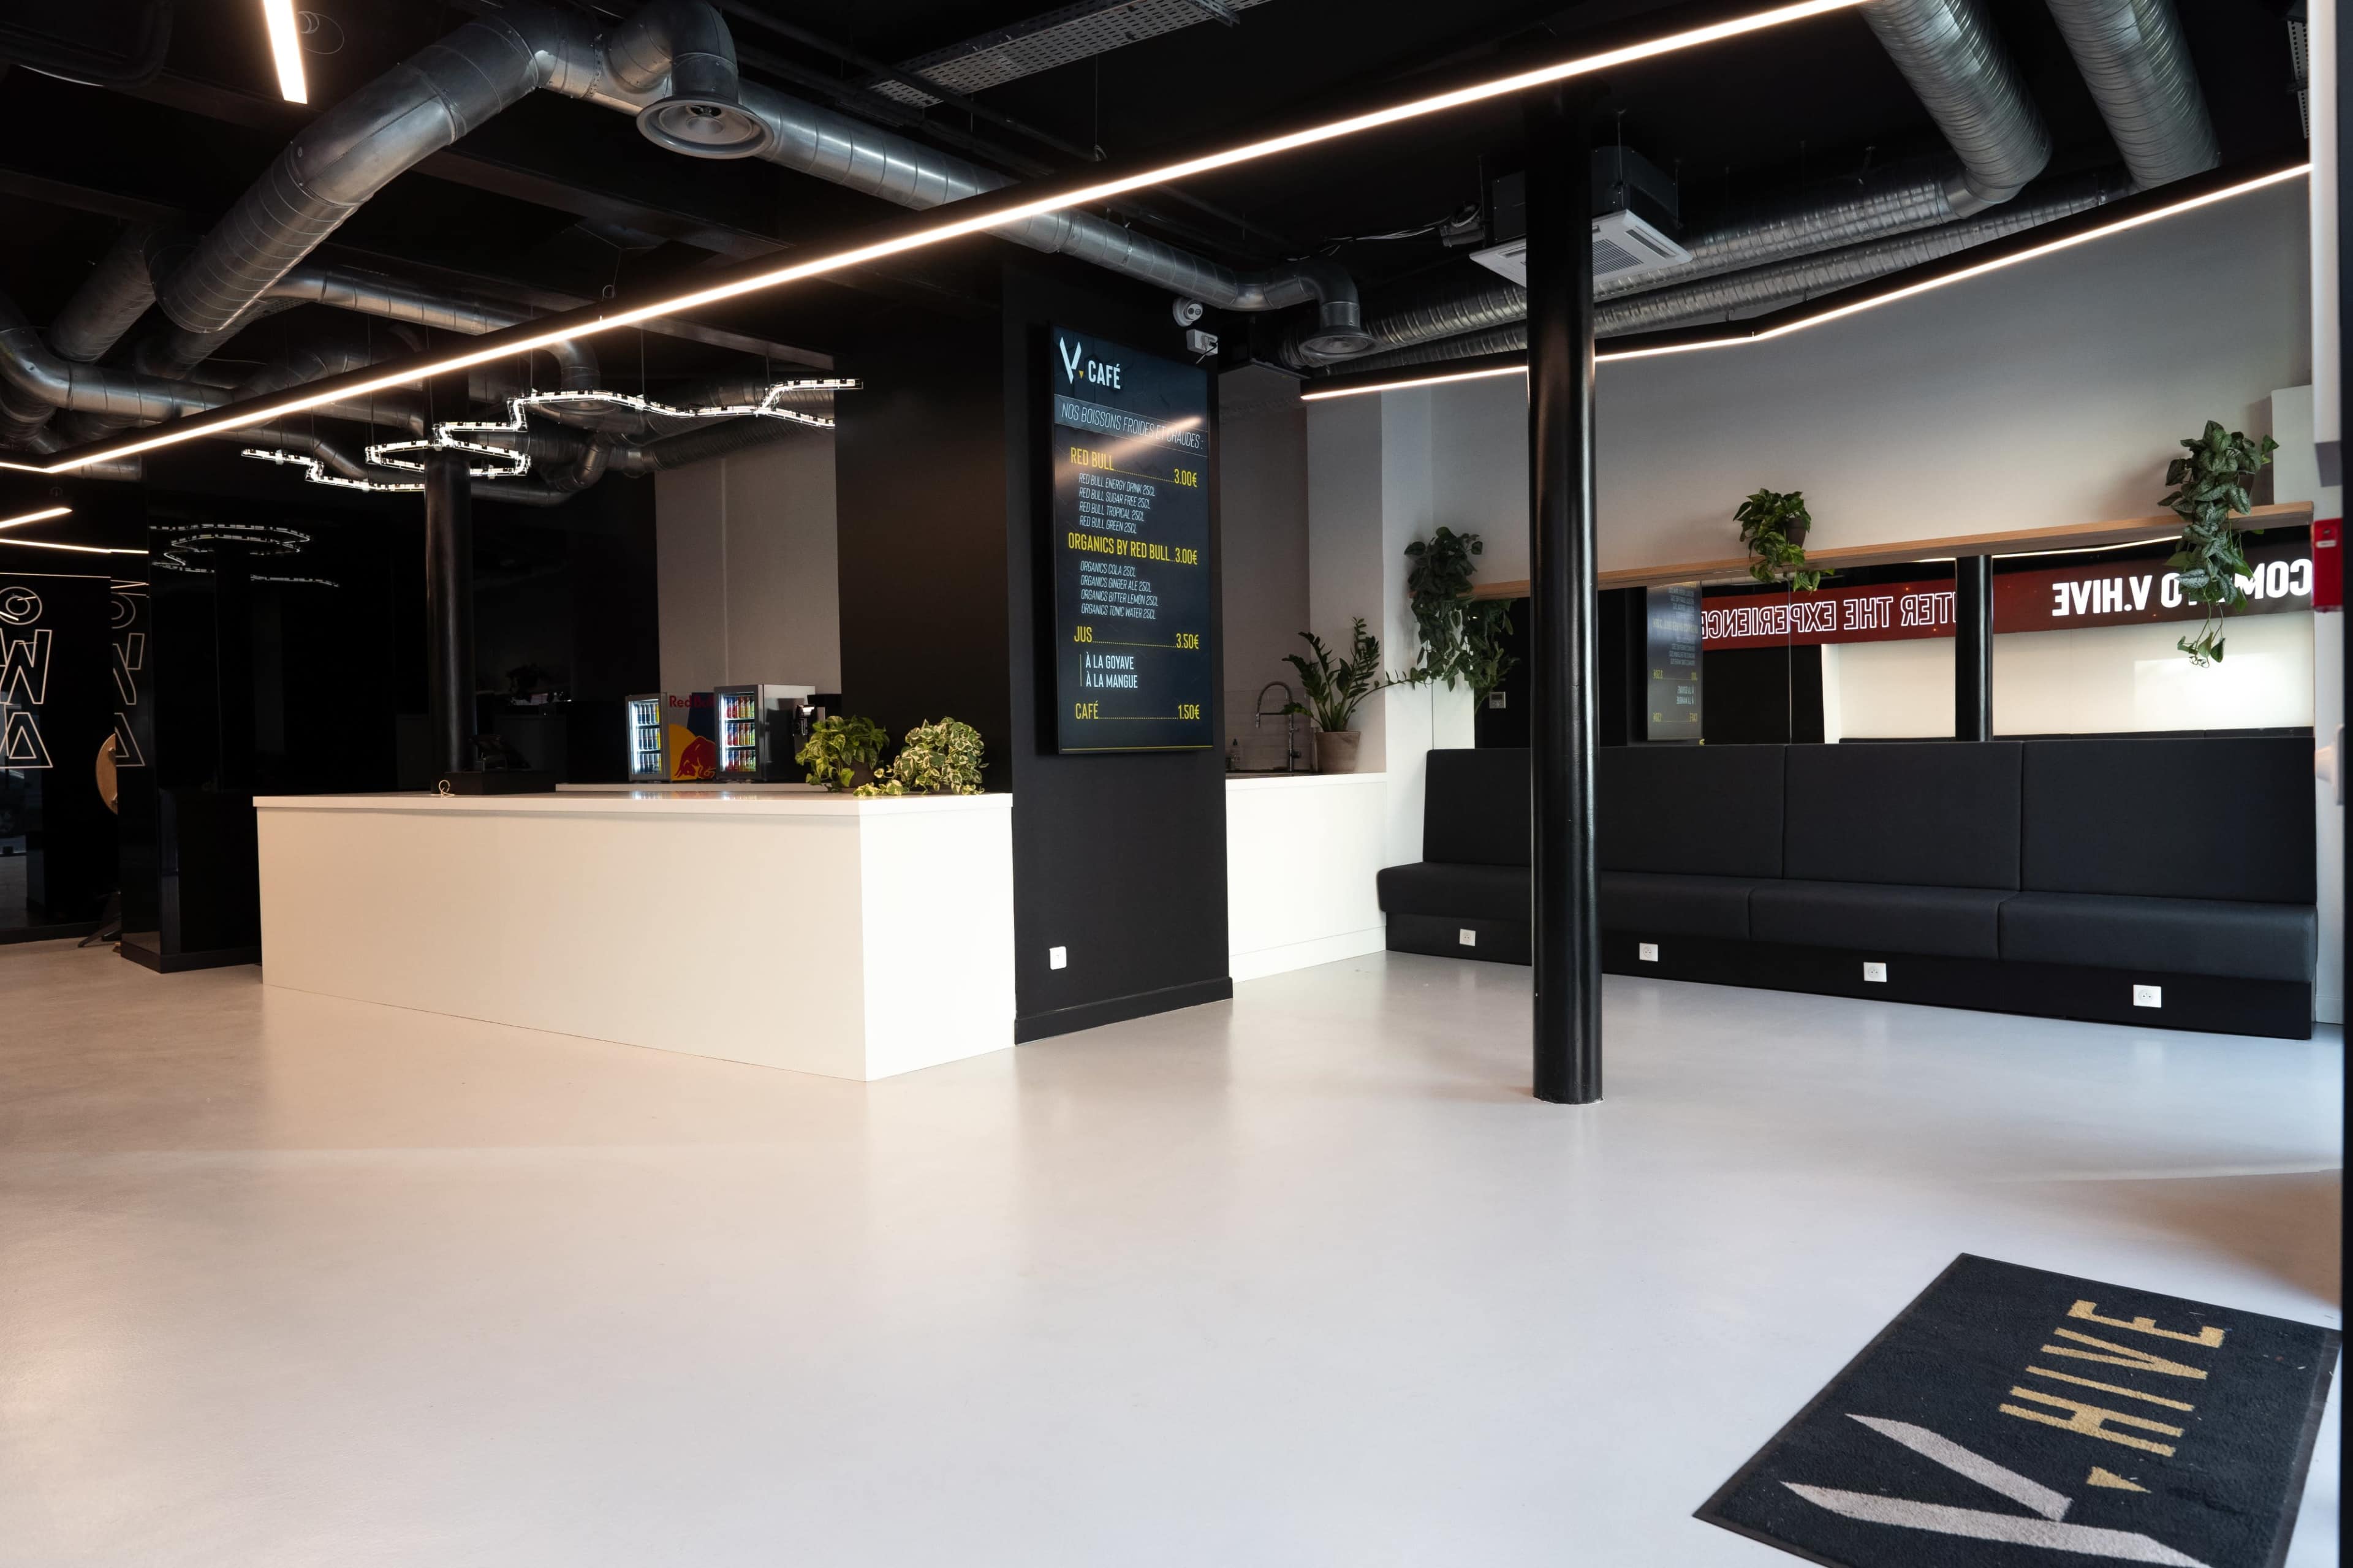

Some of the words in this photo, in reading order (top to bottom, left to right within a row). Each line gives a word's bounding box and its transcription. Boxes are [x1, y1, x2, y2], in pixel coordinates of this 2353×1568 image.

[1088, 360, 1121, 389] CAFÉ
[1062, 403, 1079, 420] NOS
[1081, 407, 1121, 431] BOISSONS
[1123, 417, 1154, 437] FROIDES
[1156, 425, 1165, 440] ET
[1070, 447, 1089, 466] RED
[1091, 451, 1114, 471] BULL
[1174, 468, 1197, 487] 3.00€
[1079, 472, 1089, 485] RED
[1091, 475, 1104, 488] BULL
[1105, 477, 1126, 491] ENERGY
[1126, 482, 1142, 494] DRINK
[1143, 486, 1155, 496] 25CL
[1079, 487, 1089, 499] RED
[1091, 489, 1104, 501] BULL
[1105, 491, 1123, 503] SUGAR
[1124, 494, 1137, 507] FREE
[1137, 498, 1150, 509] 25CL
[1079, 501, 1090, 513] RED
[1091, 503, 1104, 515] BULL
[1107, 506, 1130, 520] TROPICAL
[1131, 510, 1144, 521] 25CL
[1080, 515, 1090, 526] RED
[1091, 517, 1104, 529] BULL
[1106, 520, 1123, 531] GREEN
[1124, 522, 1137, 534] 25CL
[1068, 532, 1114, 554] ORGANICS
[1117, 539, 1127, 555] BY
[1131, 541, 1146, 558] RED
[1150, 544, 1170, 561] BULL
[1175, 548, 1197, 565] 3.00€
[1080, 561, 1107, 574] ORGANICS
[1108, 564, 1122, 575] COLA
[1123, 566, 1136, 577] 25CL
[1081, 575, 1107, 588] ORGANICS
[1108, 578, 1127, 590] GINGER
[1128, 581, 1137, 591] ALE
[1139, 581, 1151, 593] 25CL
[1081, 589, 1107, 602] ORGANICS
[1108, 591, 1126, 604] BITTER
[1127, 594, 1145, 605] LEMON
[1146, 596, 1158, 607] 25CL
[1082, 603, 1108, 616] ORGANICS
[1109, 605, 1124, 616] TONIC
[1125, 608, 1142, 619] WATER
[1143, 610, 1156, 619] 25CL
[1074, 626, 1093, 643] JUS
[1176, 633, 1199, 650] 3.50€
[1085, 651, 1091, 668] À
[1093, 654, 1103, 668] LA
[1105, 655, 1134, 670] GOYAVE
[1086, 670, 1091, 687] À
[1094, 673, 1104, 687] LA
[1106, 674, 1138, 688] MANGUE
[669, 694, 692, 708] Red
[1075, 700, 1099, 719] CAFÉ
[1178, 705, 1200, 719] 1.50€
[1998, 1300, 2226, 1458] HIVE
